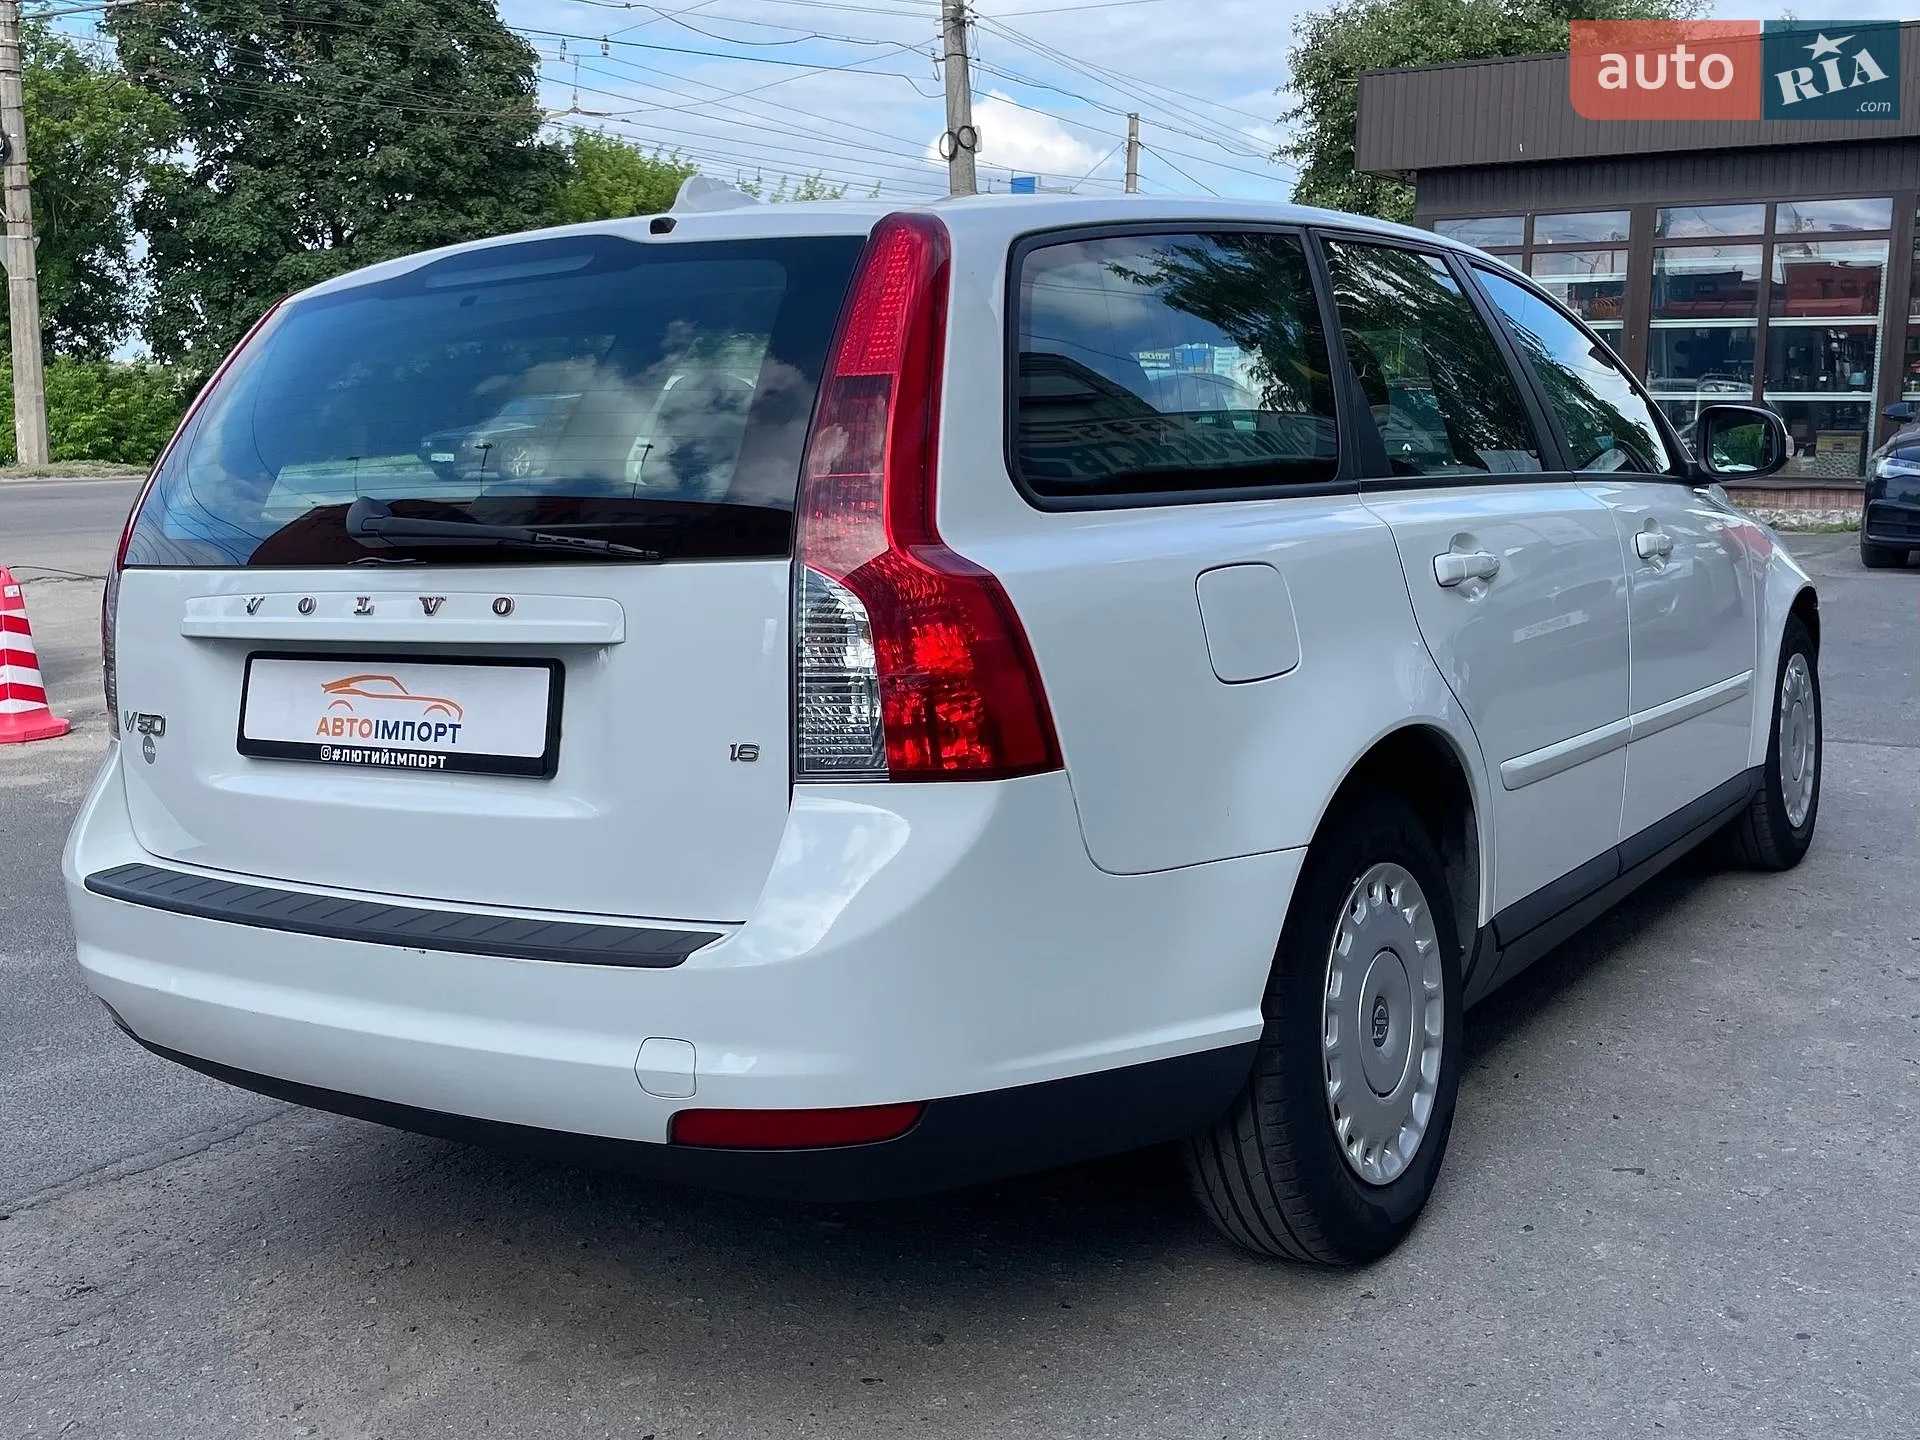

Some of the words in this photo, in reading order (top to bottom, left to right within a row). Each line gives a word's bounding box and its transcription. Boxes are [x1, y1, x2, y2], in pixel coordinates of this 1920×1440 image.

[242, 596, 516, 617] VOLVO
[122, 710, 167, 737] V50
[316, 716, 462, 744] АВТОІМПОРТ
